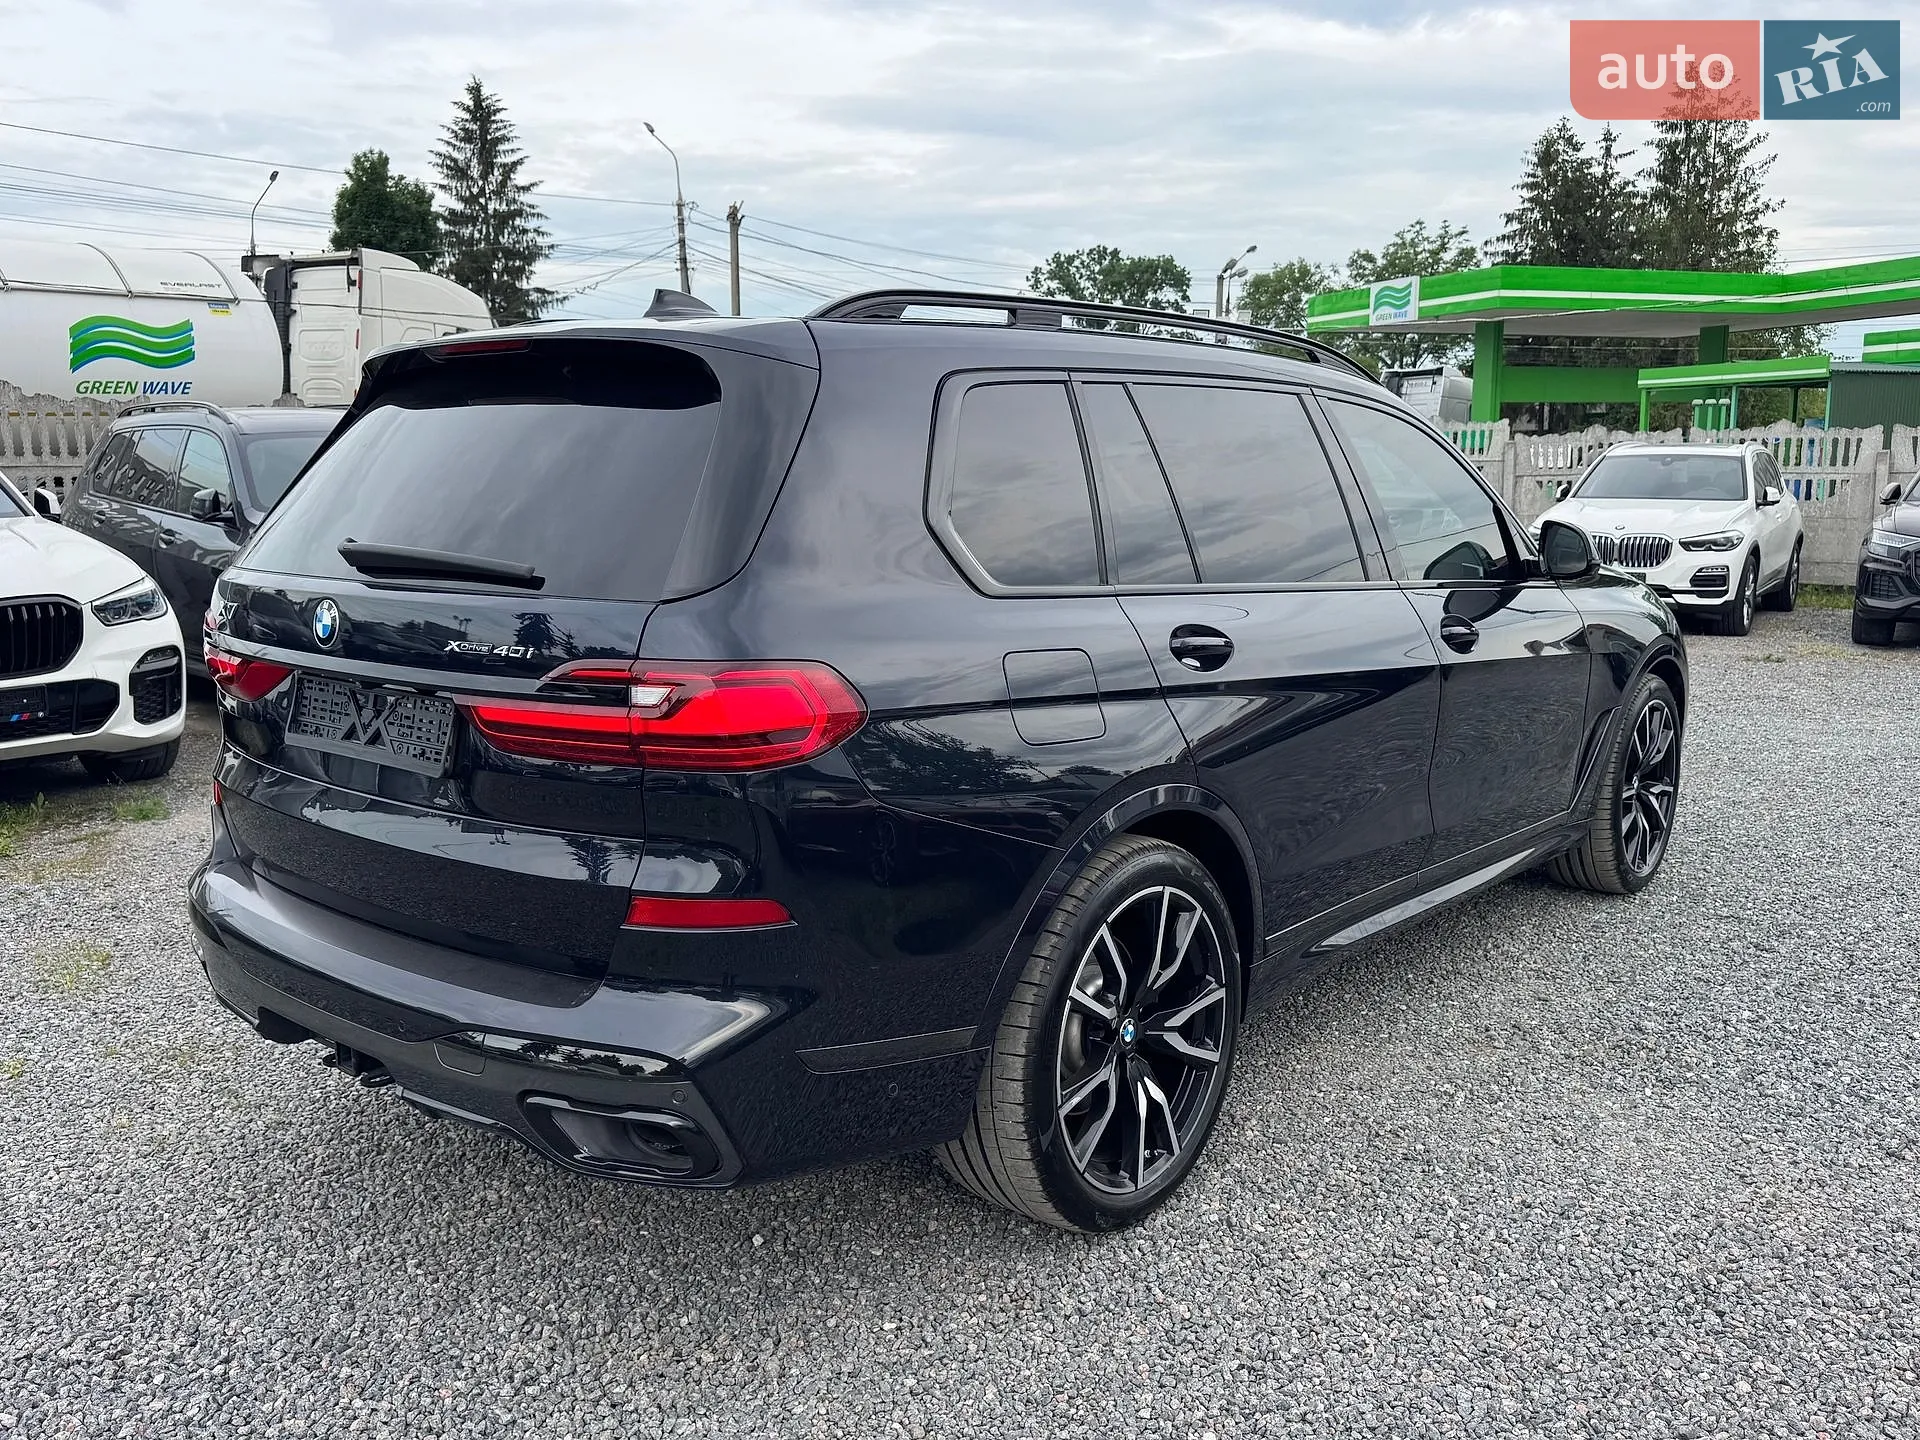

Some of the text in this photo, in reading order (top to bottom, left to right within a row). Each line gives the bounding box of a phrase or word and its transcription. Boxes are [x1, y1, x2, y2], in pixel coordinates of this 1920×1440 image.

[1375, 313, 1392, 321] GREEN
[75, 380, 193, 395] GREEN WAVE
